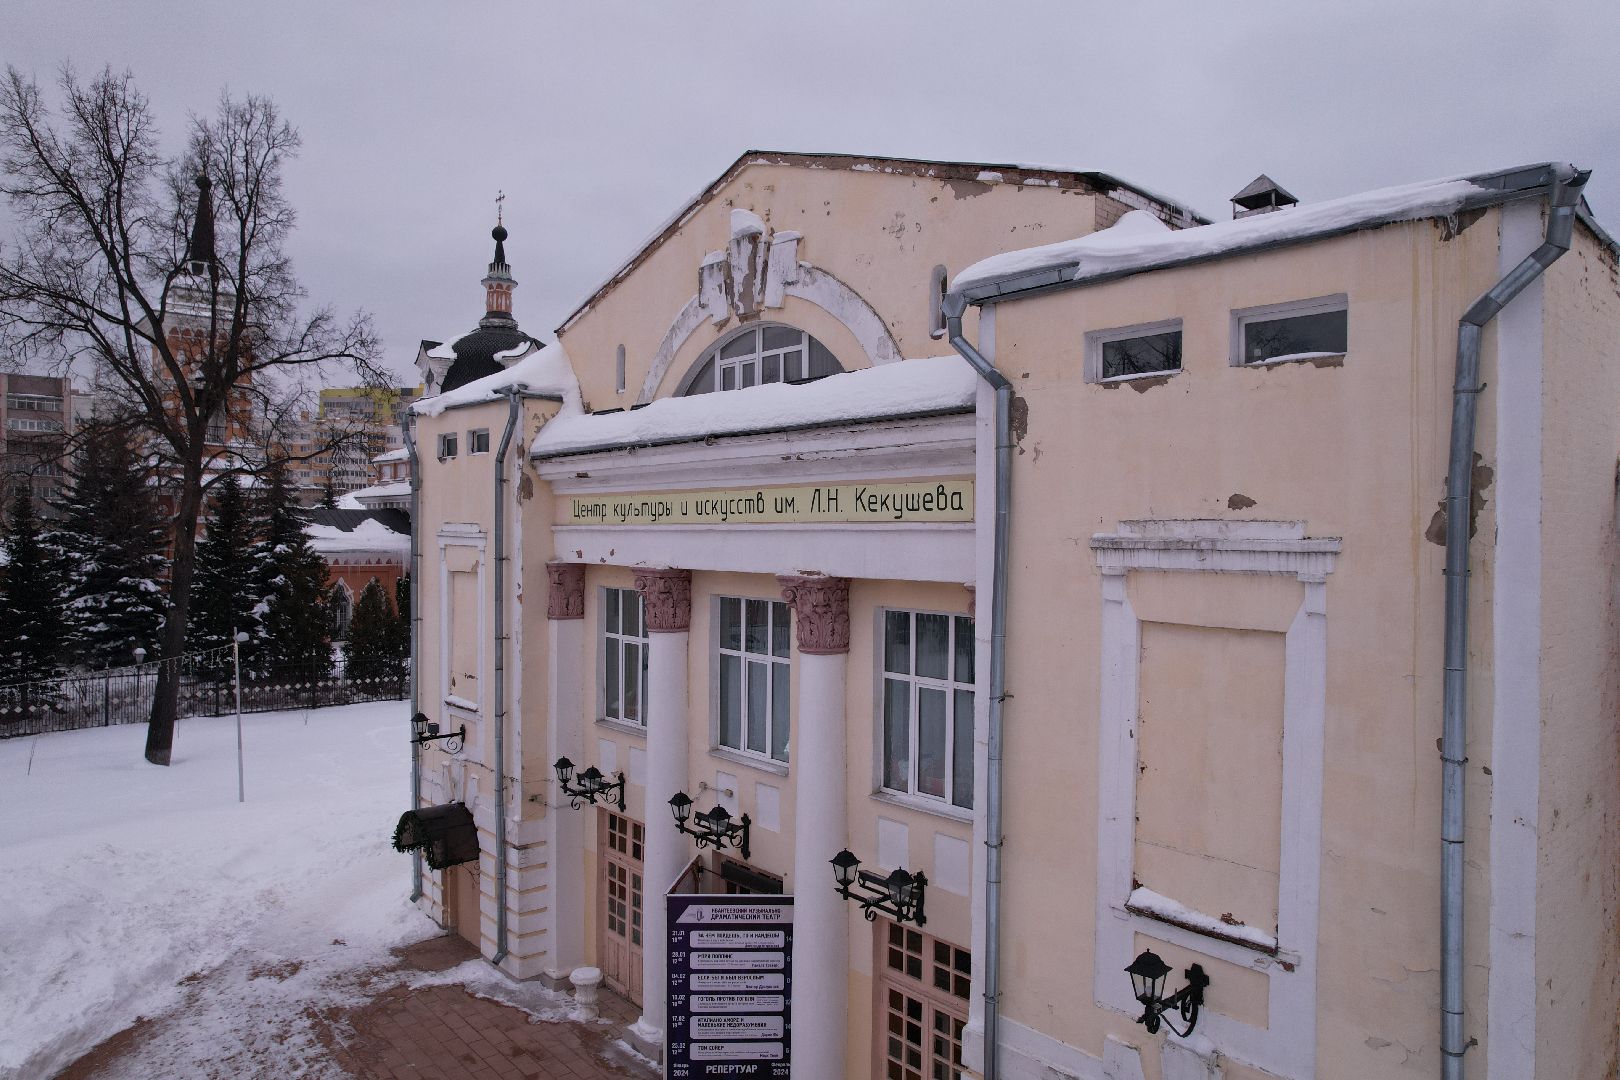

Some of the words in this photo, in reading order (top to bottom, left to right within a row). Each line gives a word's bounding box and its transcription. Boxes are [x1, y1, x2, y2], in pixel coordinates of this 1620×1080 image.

[573, 499, 607, 522] Центр
[613, 501, 673, 522] культуры
[681, 501, 688, 515] и
[695, 491, 765, 521] искусств
[774, 496, 800, 514] им.
[810, 488, 844, 513] Л.Н.
[855, 484, 965, 520] Кекушева
[673, 1069, 689, 1077] 2024
[705, 1064, 758, 1074] РЕПЕРТУАР
[772, 1068, 789, 1076] 2024
